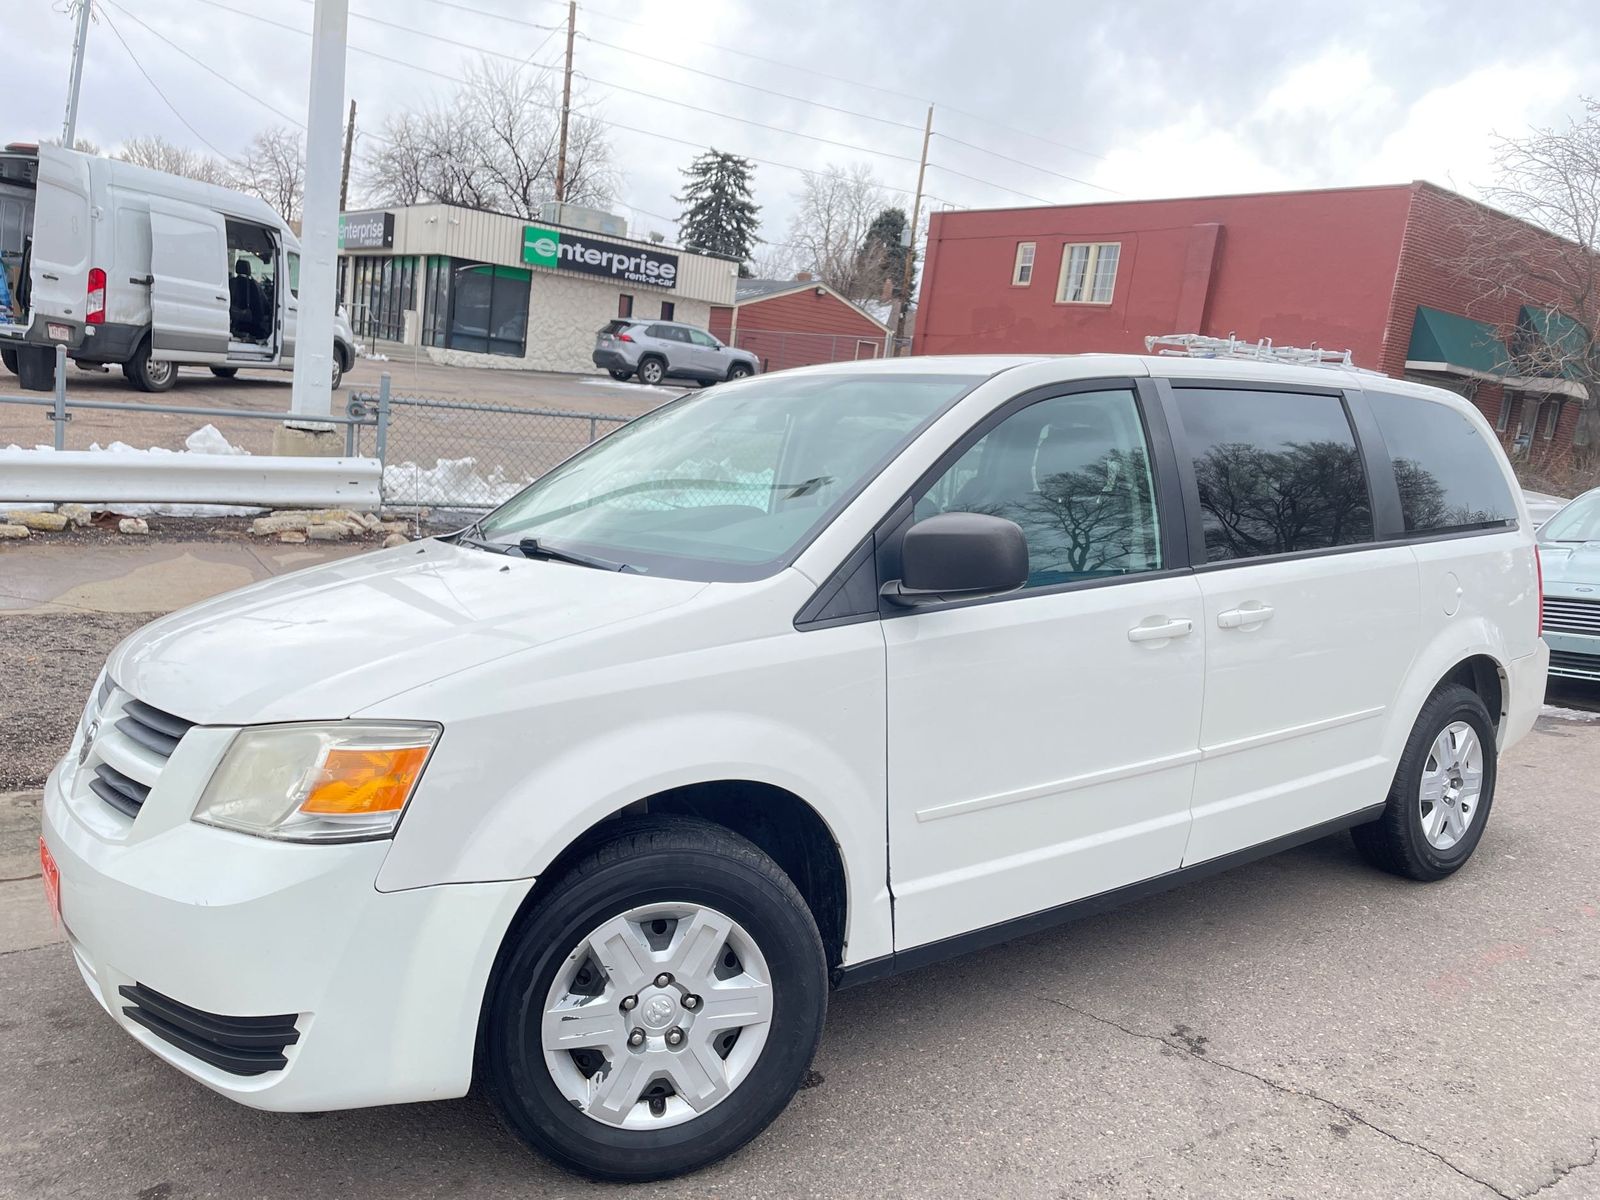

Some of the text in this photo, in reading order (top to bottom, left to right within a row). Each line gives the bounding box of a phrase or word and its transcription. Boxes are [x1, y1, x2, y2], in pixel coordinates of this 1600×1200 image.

[338, 219, 384, 244] enterprise
[530, 238, 676, 279] enterprise
[624, 271, 675, 287] rent-a-car
